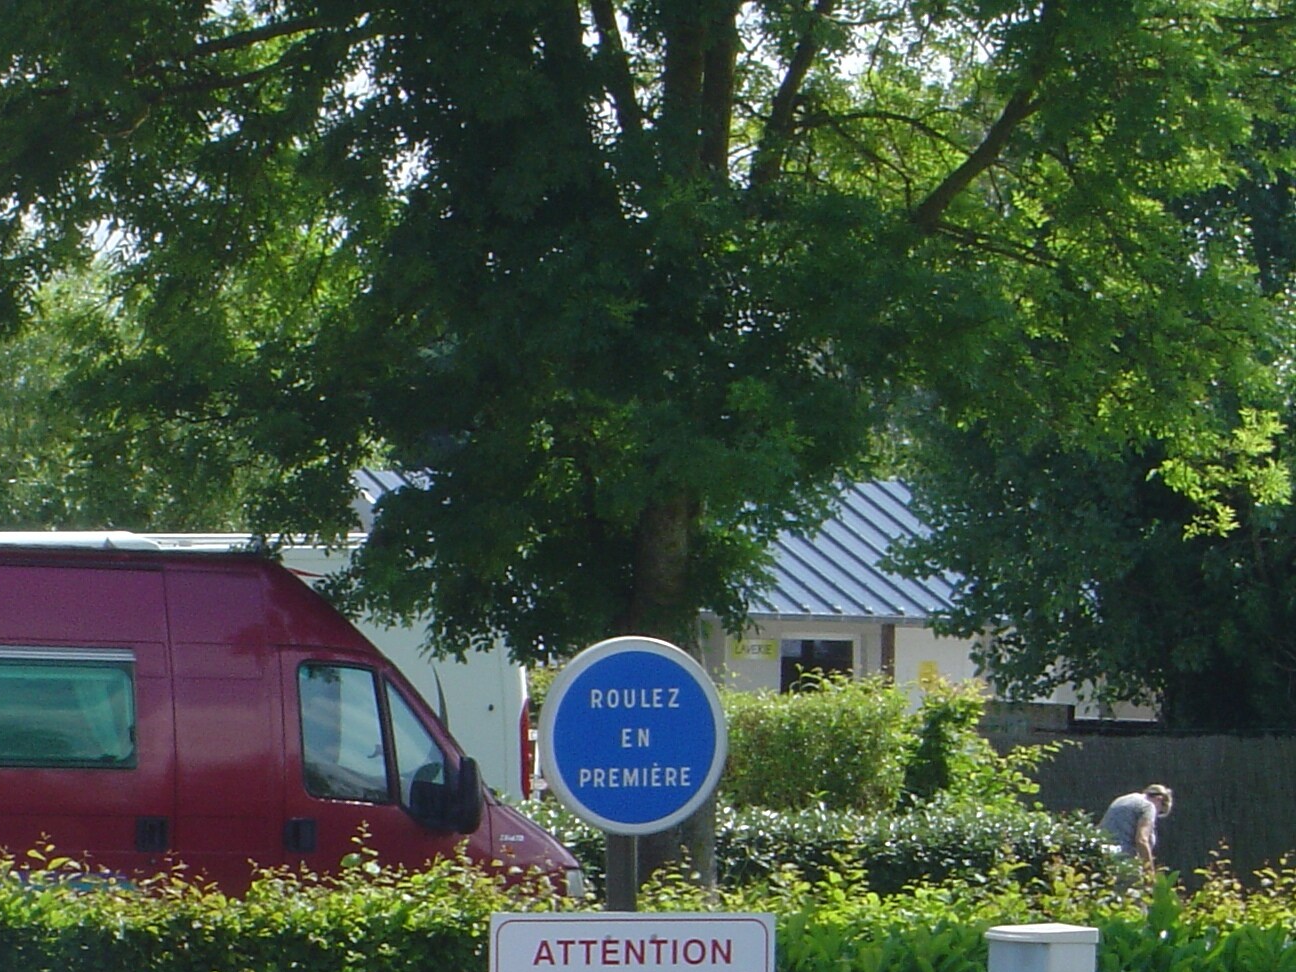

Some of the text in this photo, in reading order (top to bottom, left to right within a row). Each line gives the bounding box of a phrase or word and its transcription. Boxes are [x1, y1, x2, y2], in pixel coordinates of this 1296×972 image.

[590, 688, 680, 708] ROULEZ
[621, 728, 650, 748] EN
[579, 762, 691, 788] PREMIÈRE
[533, 938, 732, 965] ATTENTION
